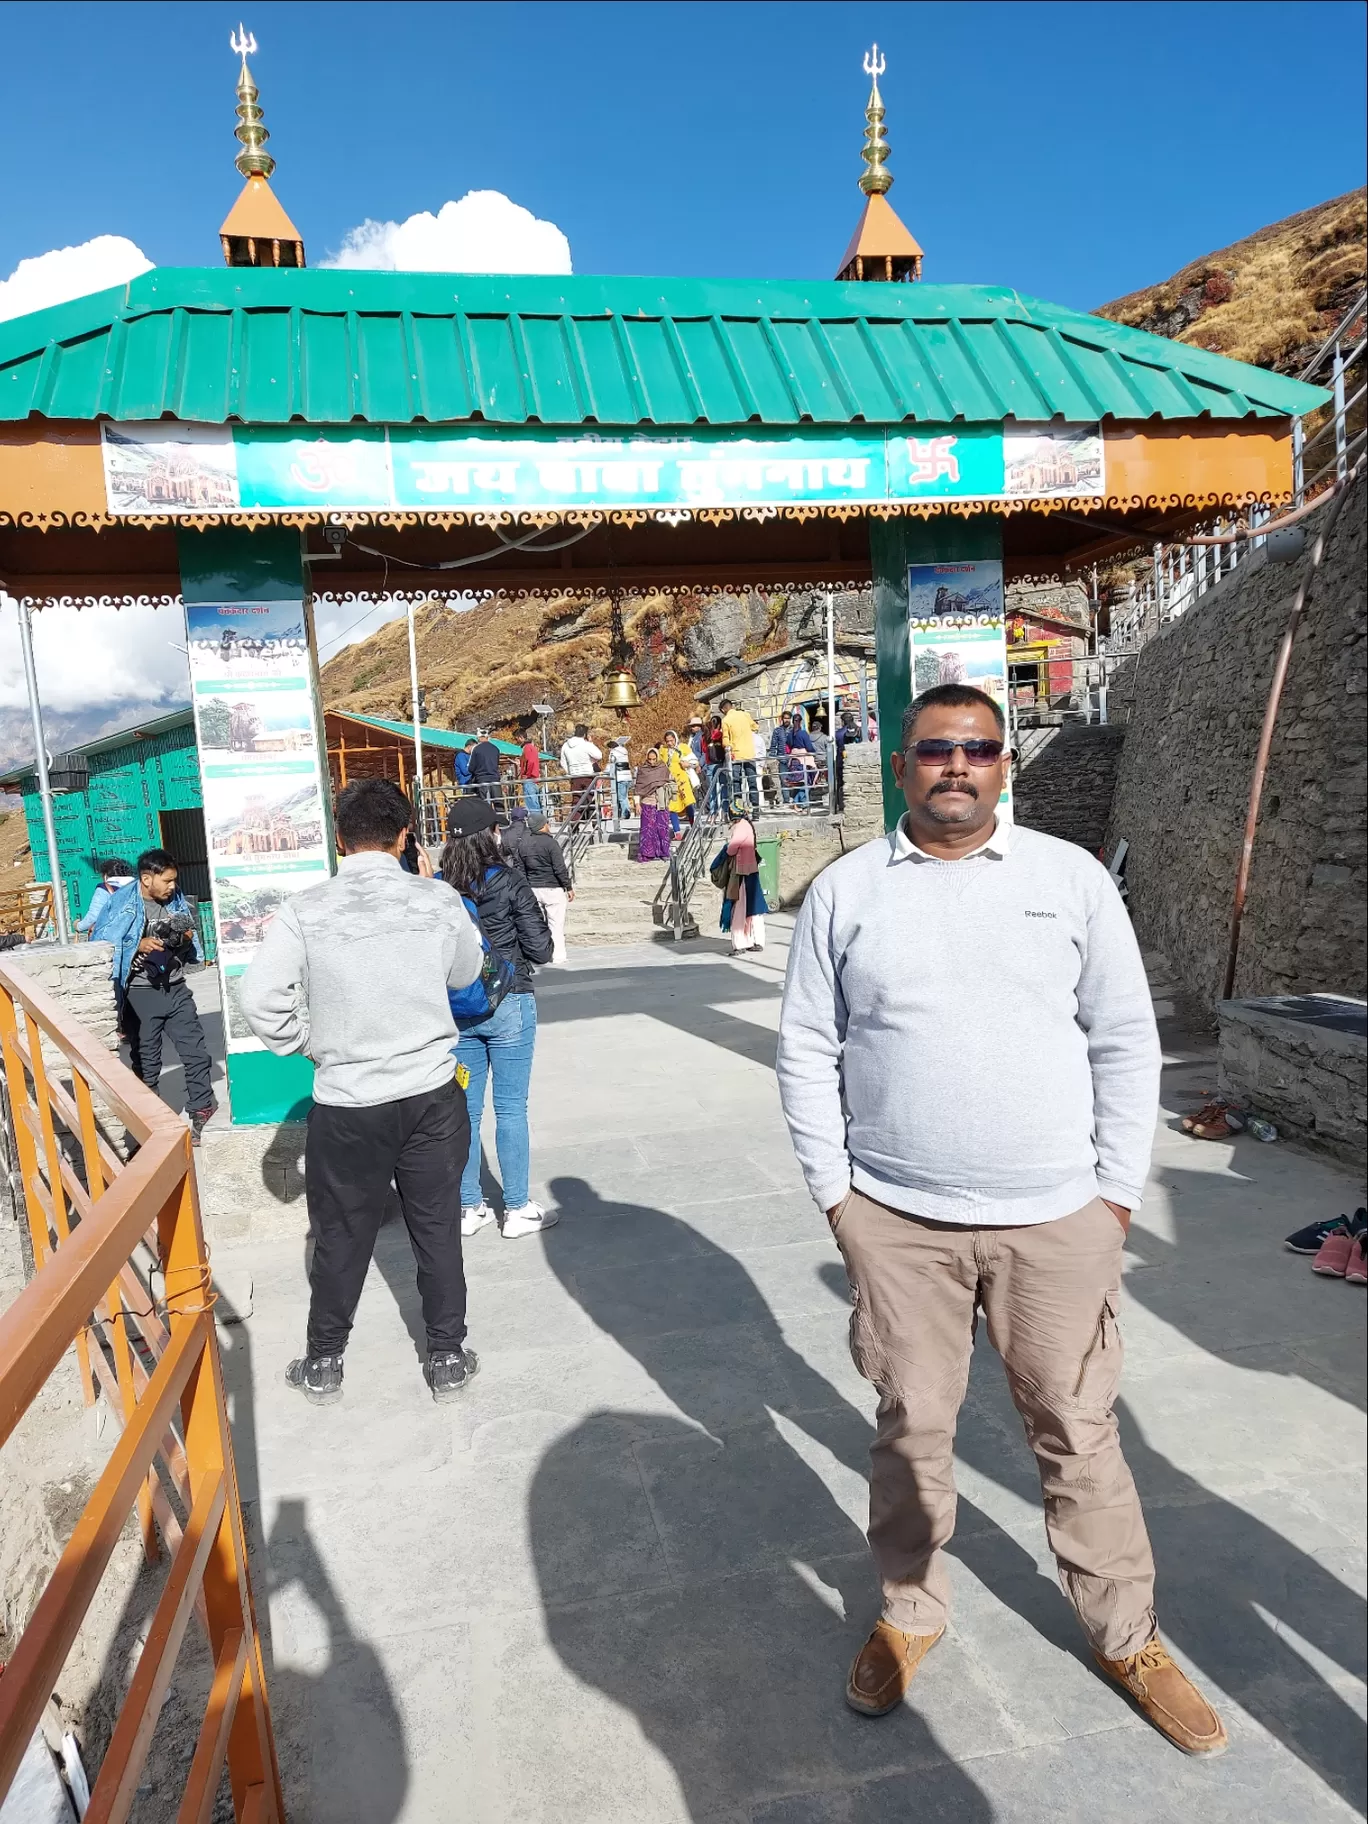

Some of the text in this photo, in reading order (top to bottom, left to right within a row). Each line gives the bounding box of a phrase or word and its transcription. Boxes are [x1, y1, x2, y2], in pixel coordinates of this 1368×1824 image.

[410, 461, 521, 494] जय
[535, 460, 664, 493] बाबा
[1024, 910, 1058, 919] Reebok
